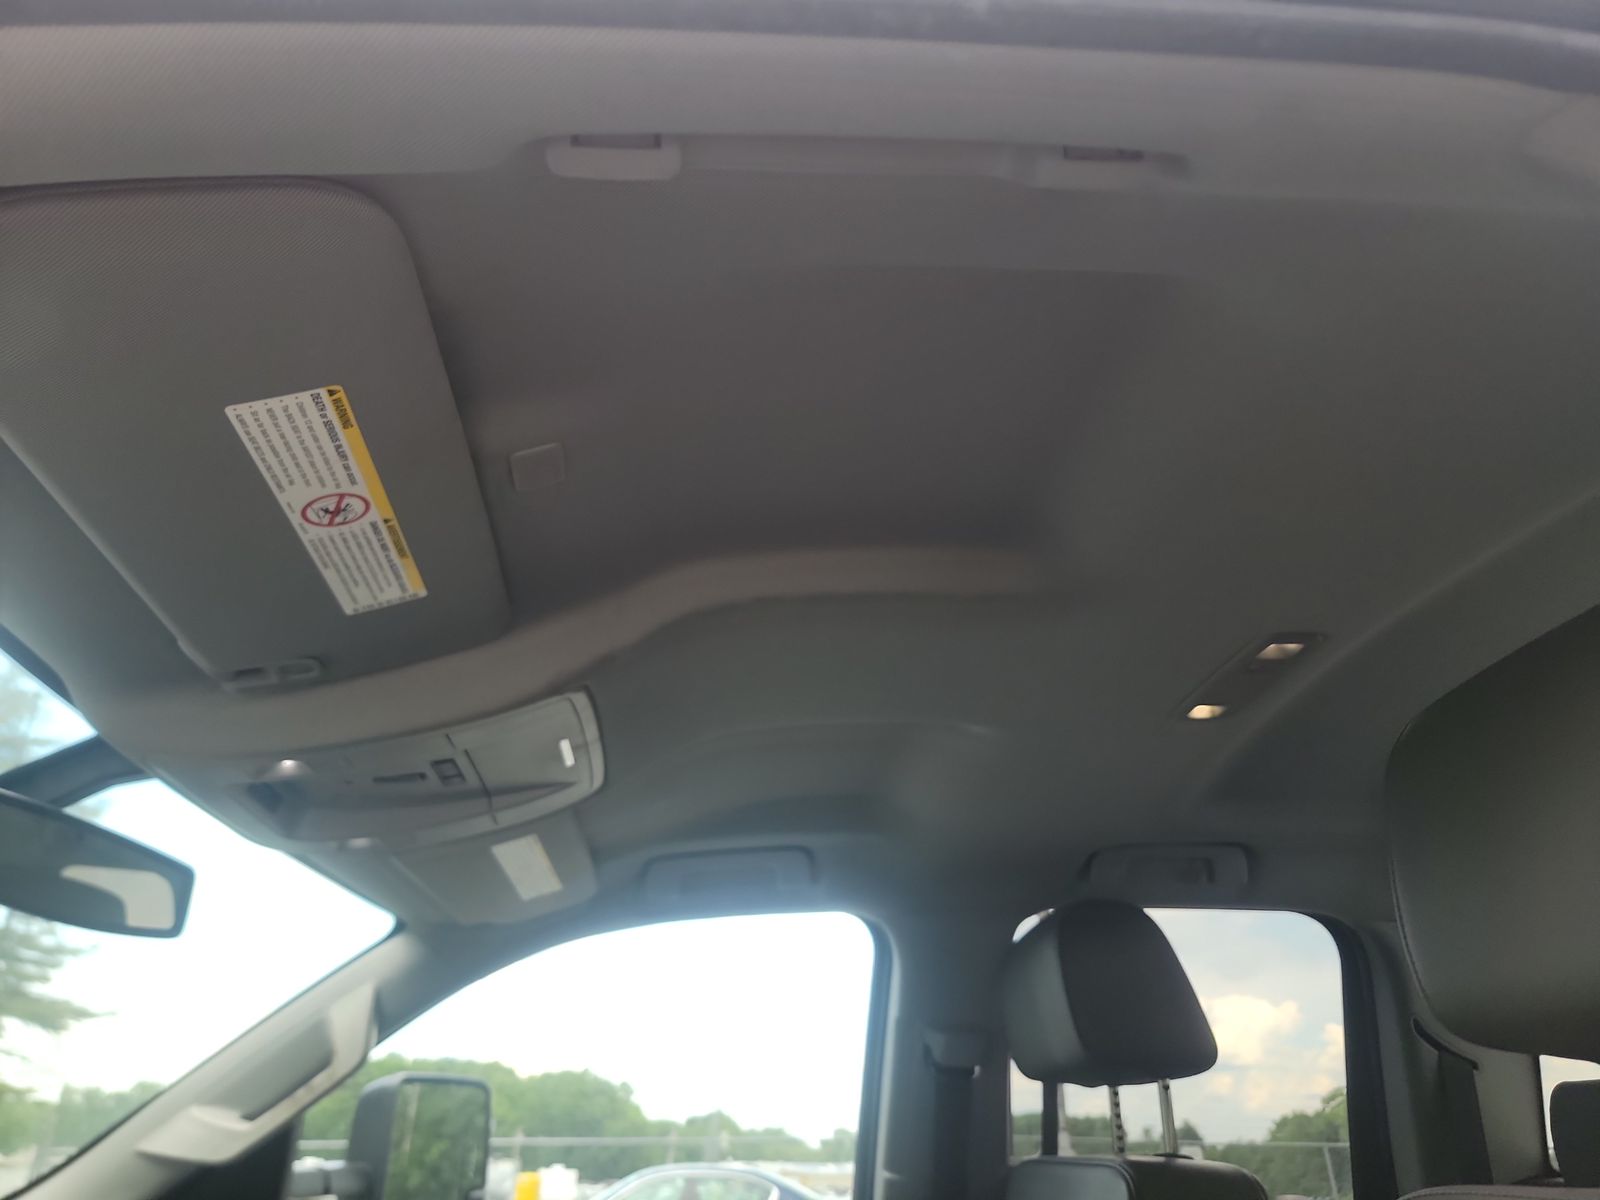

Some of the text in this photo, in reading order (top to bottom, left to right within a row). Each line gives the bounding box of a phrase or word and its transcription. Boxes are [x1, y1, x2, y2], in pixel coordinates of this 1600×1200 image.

[309, 392, 327, 412] DEATH
[322, 419, 341, 443] SERIOUS
[333, 443, 349, 462] INJURY
[330, 397, 354, 430] WARNING
